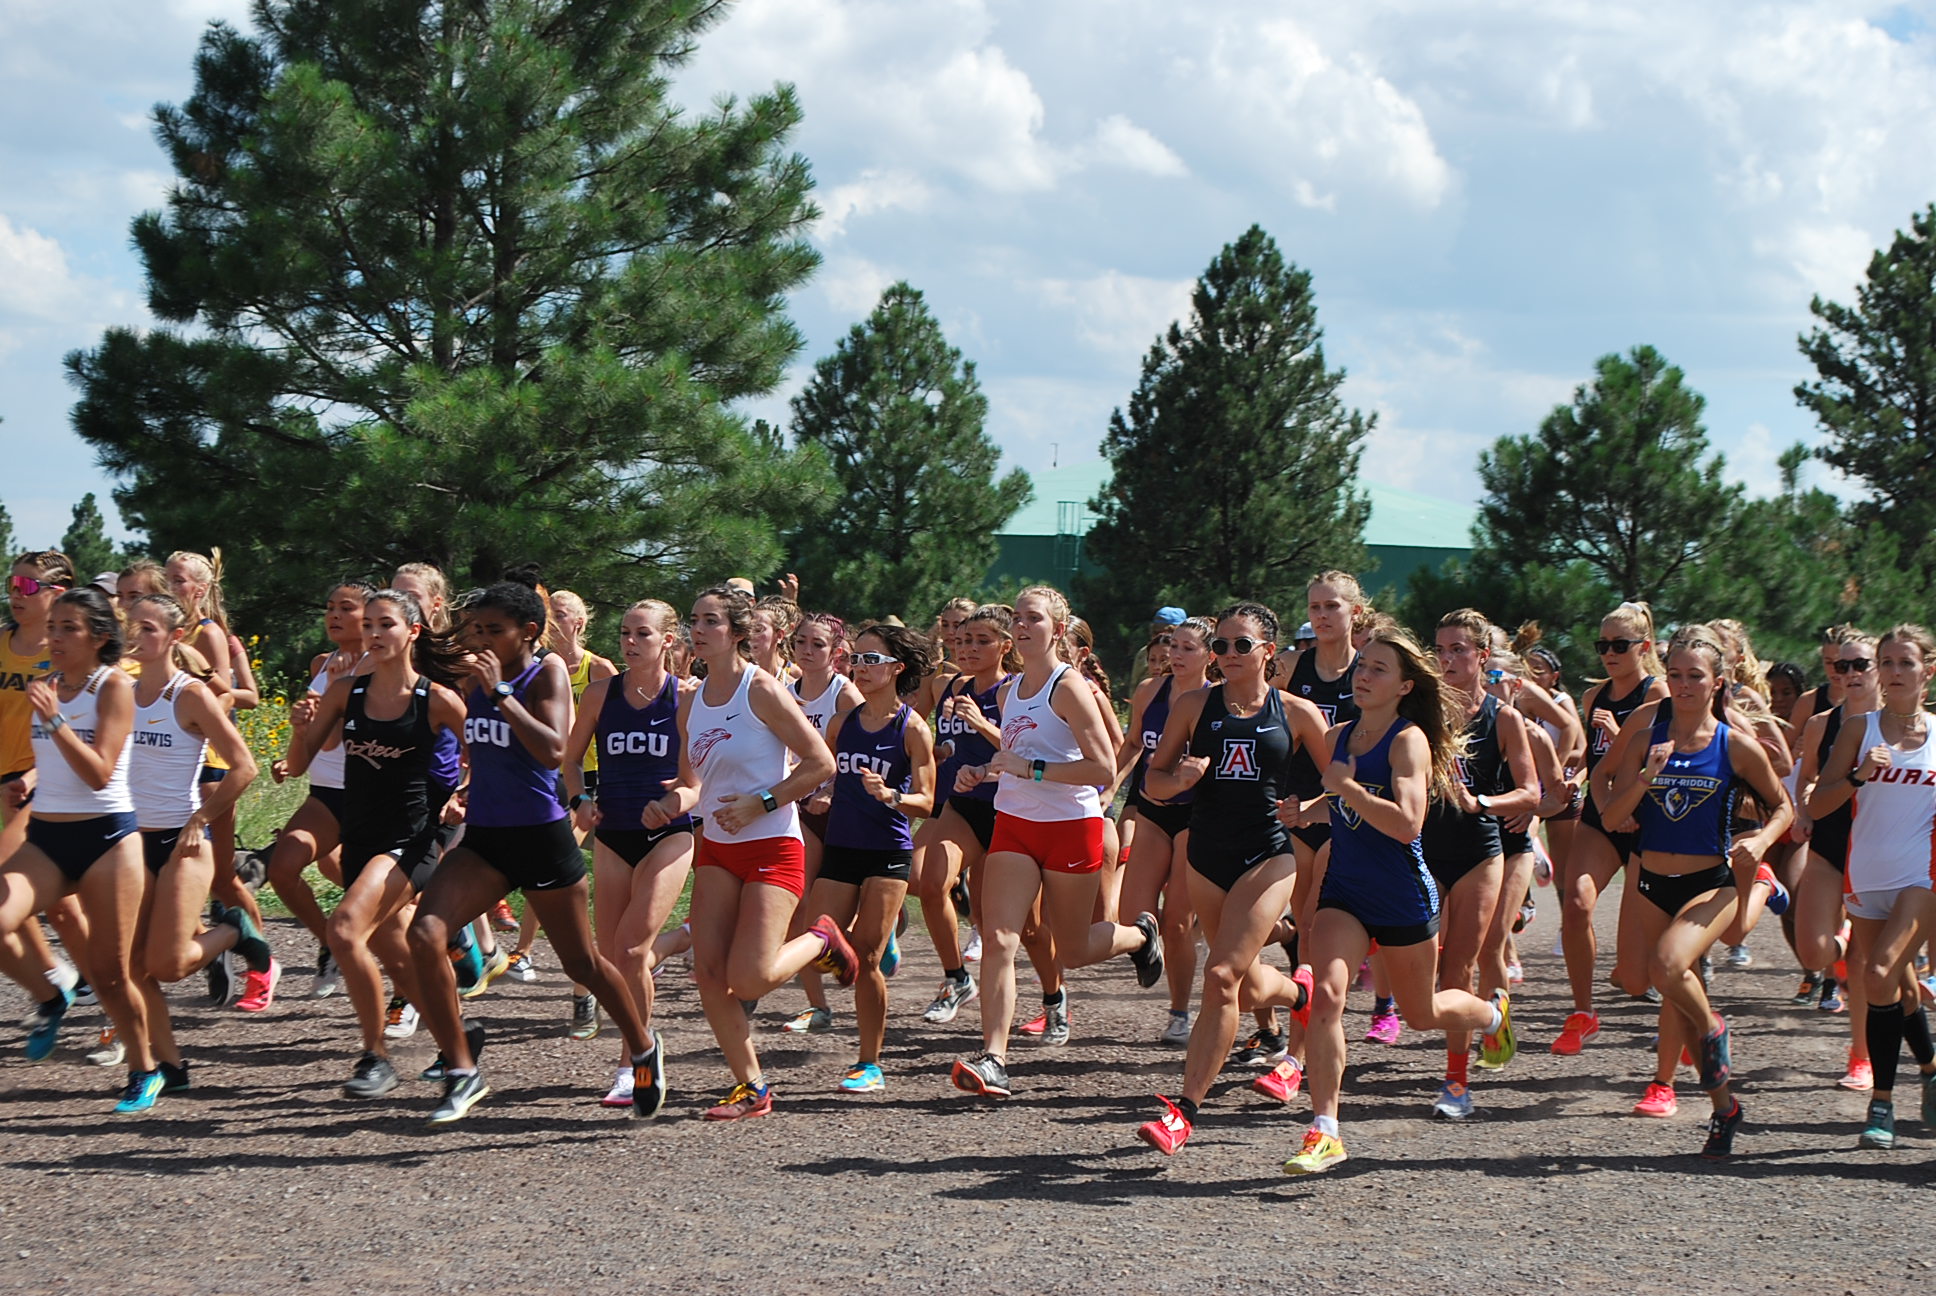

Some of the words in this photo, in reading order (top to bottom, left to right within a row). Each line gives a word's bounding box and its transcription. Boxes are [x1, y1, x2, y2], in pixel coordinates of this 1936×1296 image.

[133, 731, 172, 747] LEWIS
[464, 717, 511, 748] GCU
[606, 731, 669, 757] GCU
[836, 752, 891, 780] GCU
[1215, 738, 1261, 781] A
